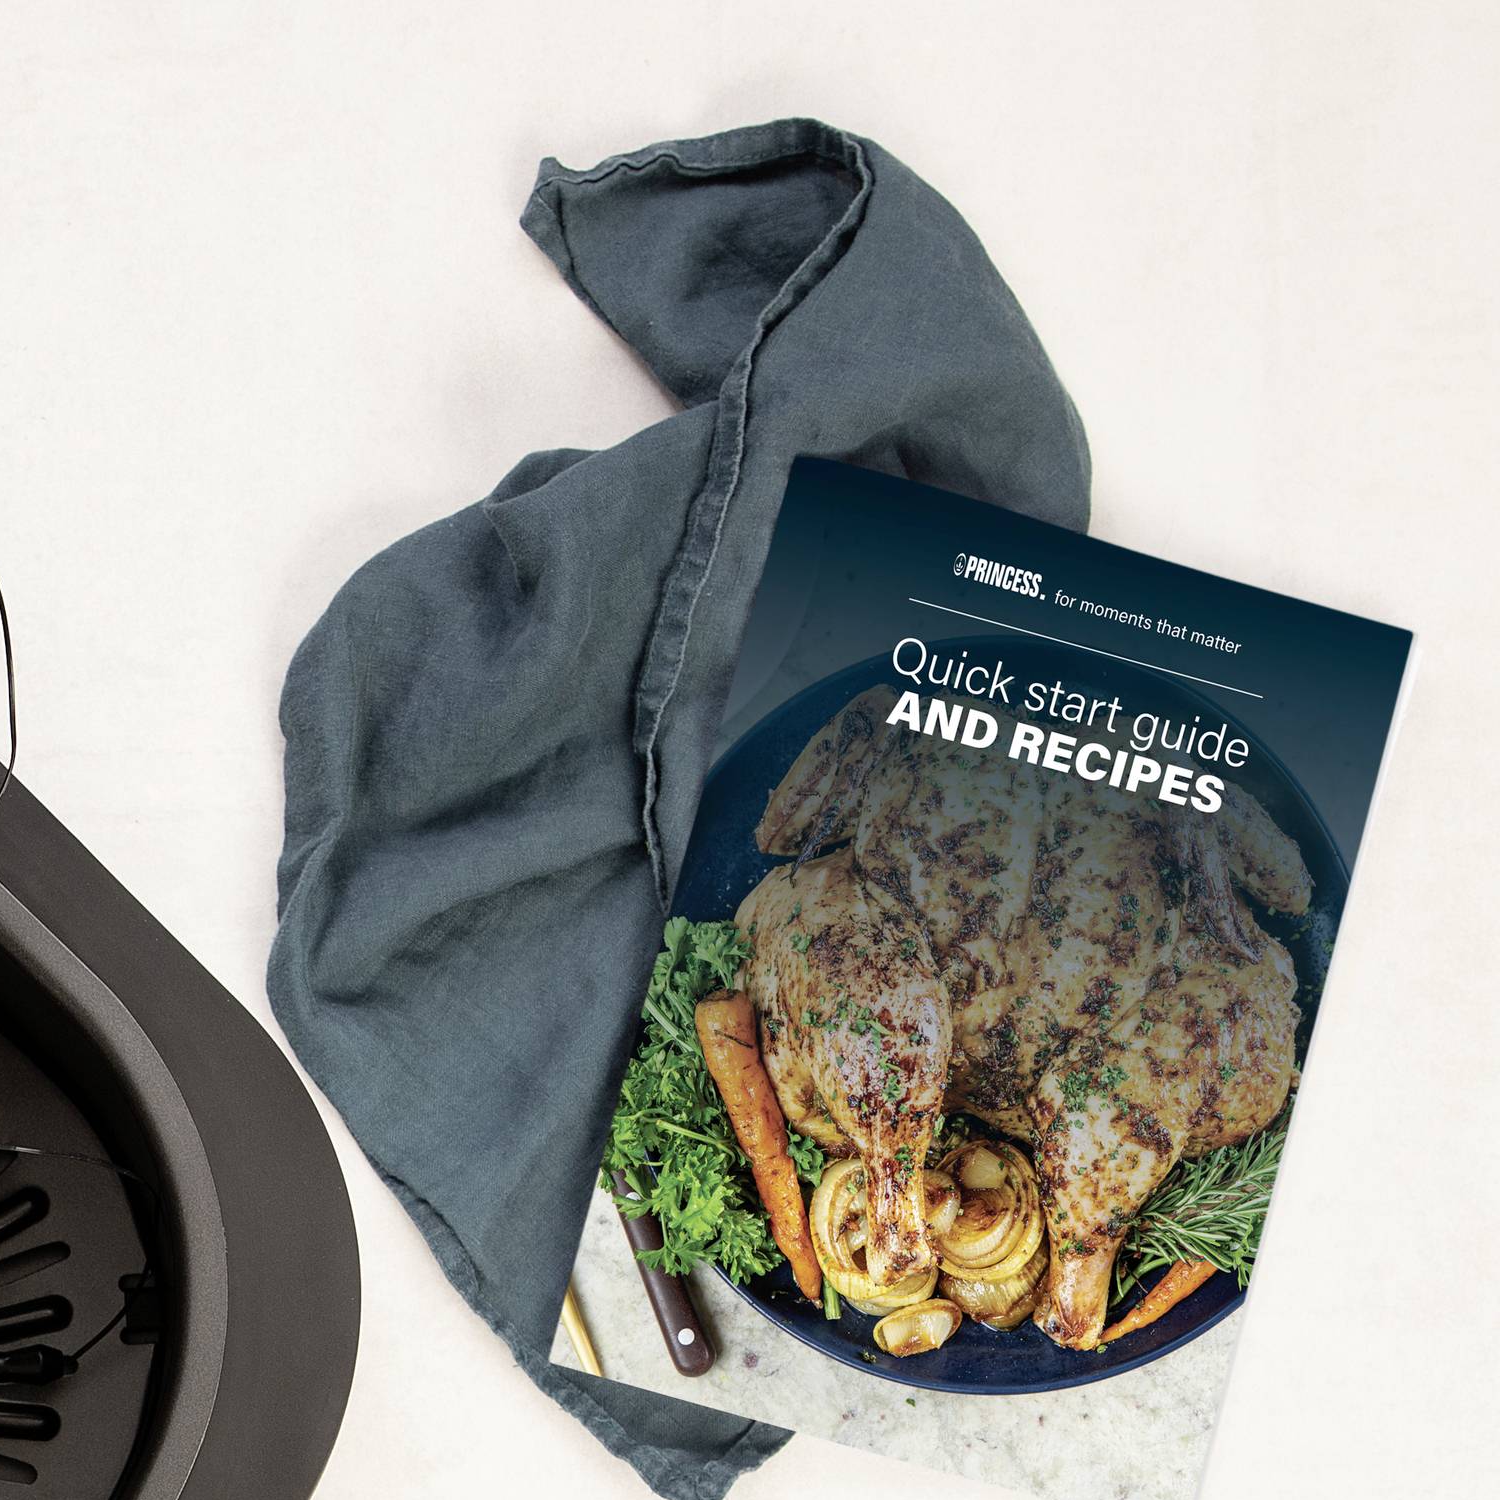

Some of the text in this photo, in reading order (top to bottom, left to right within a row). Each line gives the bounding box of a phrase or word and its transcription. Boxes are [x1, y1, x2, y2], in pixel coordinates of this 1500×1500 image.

[1054, 589, 1242, 655] for moments that matter
[885, 690, 1226, 815] AND RECIPES
[892, 637, 1251, 770] Quick start guide
